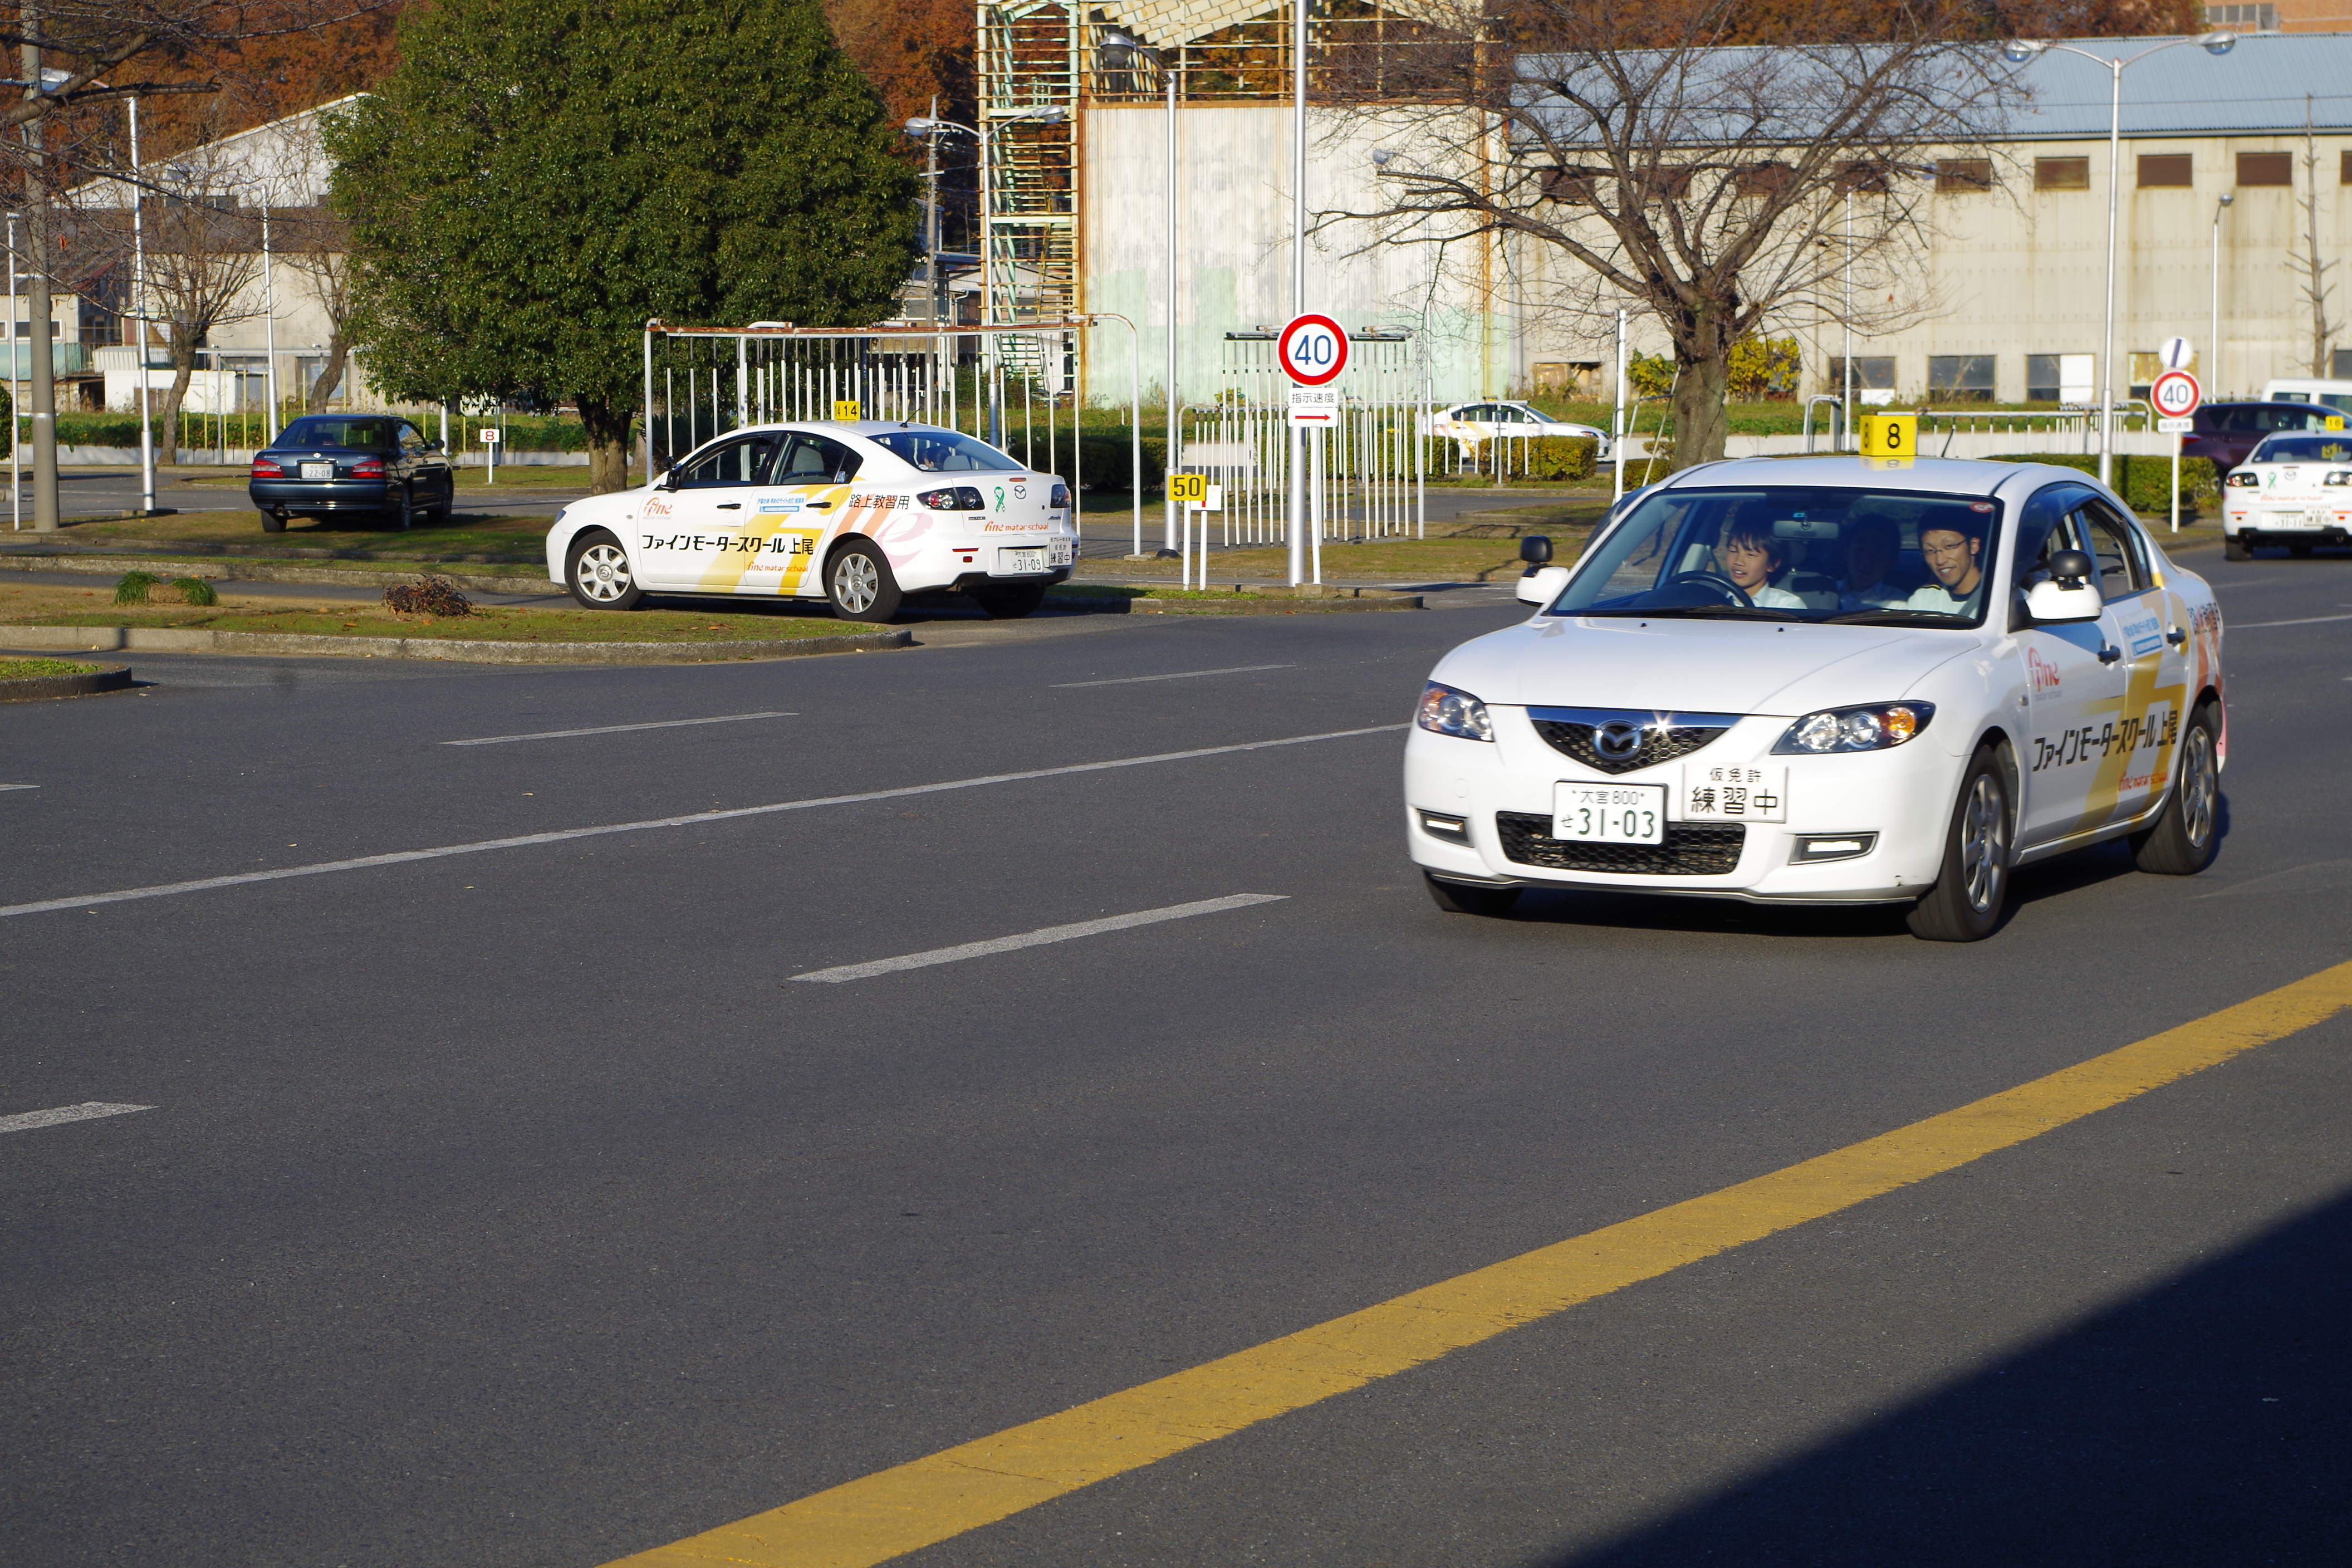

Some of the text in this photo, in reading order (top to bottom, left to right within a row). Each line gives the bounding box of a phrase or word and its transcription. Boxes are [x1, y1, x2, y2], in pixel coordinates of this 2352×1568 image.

[1295, 335, 1331, 365] 40
[1292, 393, 1335, 403] 指示速度
[2163, 384, 2188, 404] 40
[844, 405, 857, 417] 14
[486, 431, 494, 440] 8
[1888, 423, 1900, 449] 8
[1174, 477, 1200, 496] 50
[849, 494, 910, 509] 路上教習用
[984, 521, 1003, 532] fine
[642, 535, 814, 555] ファインモータースクール 上尾
[1018, 558, 1041, 570] 31-09
[1051, 552, 1070, 564] 練習中
[747, 561, 763, 571] fine
[2032, 714, 2157, 772] ファインモータースクール
[1710, 767, 1761, 782] 仮免許
[1613, 791, 1638, 805] 800
[1691, 786, 1777, 815] 練習中
[1578, 808, 1654, 838] 31-03
